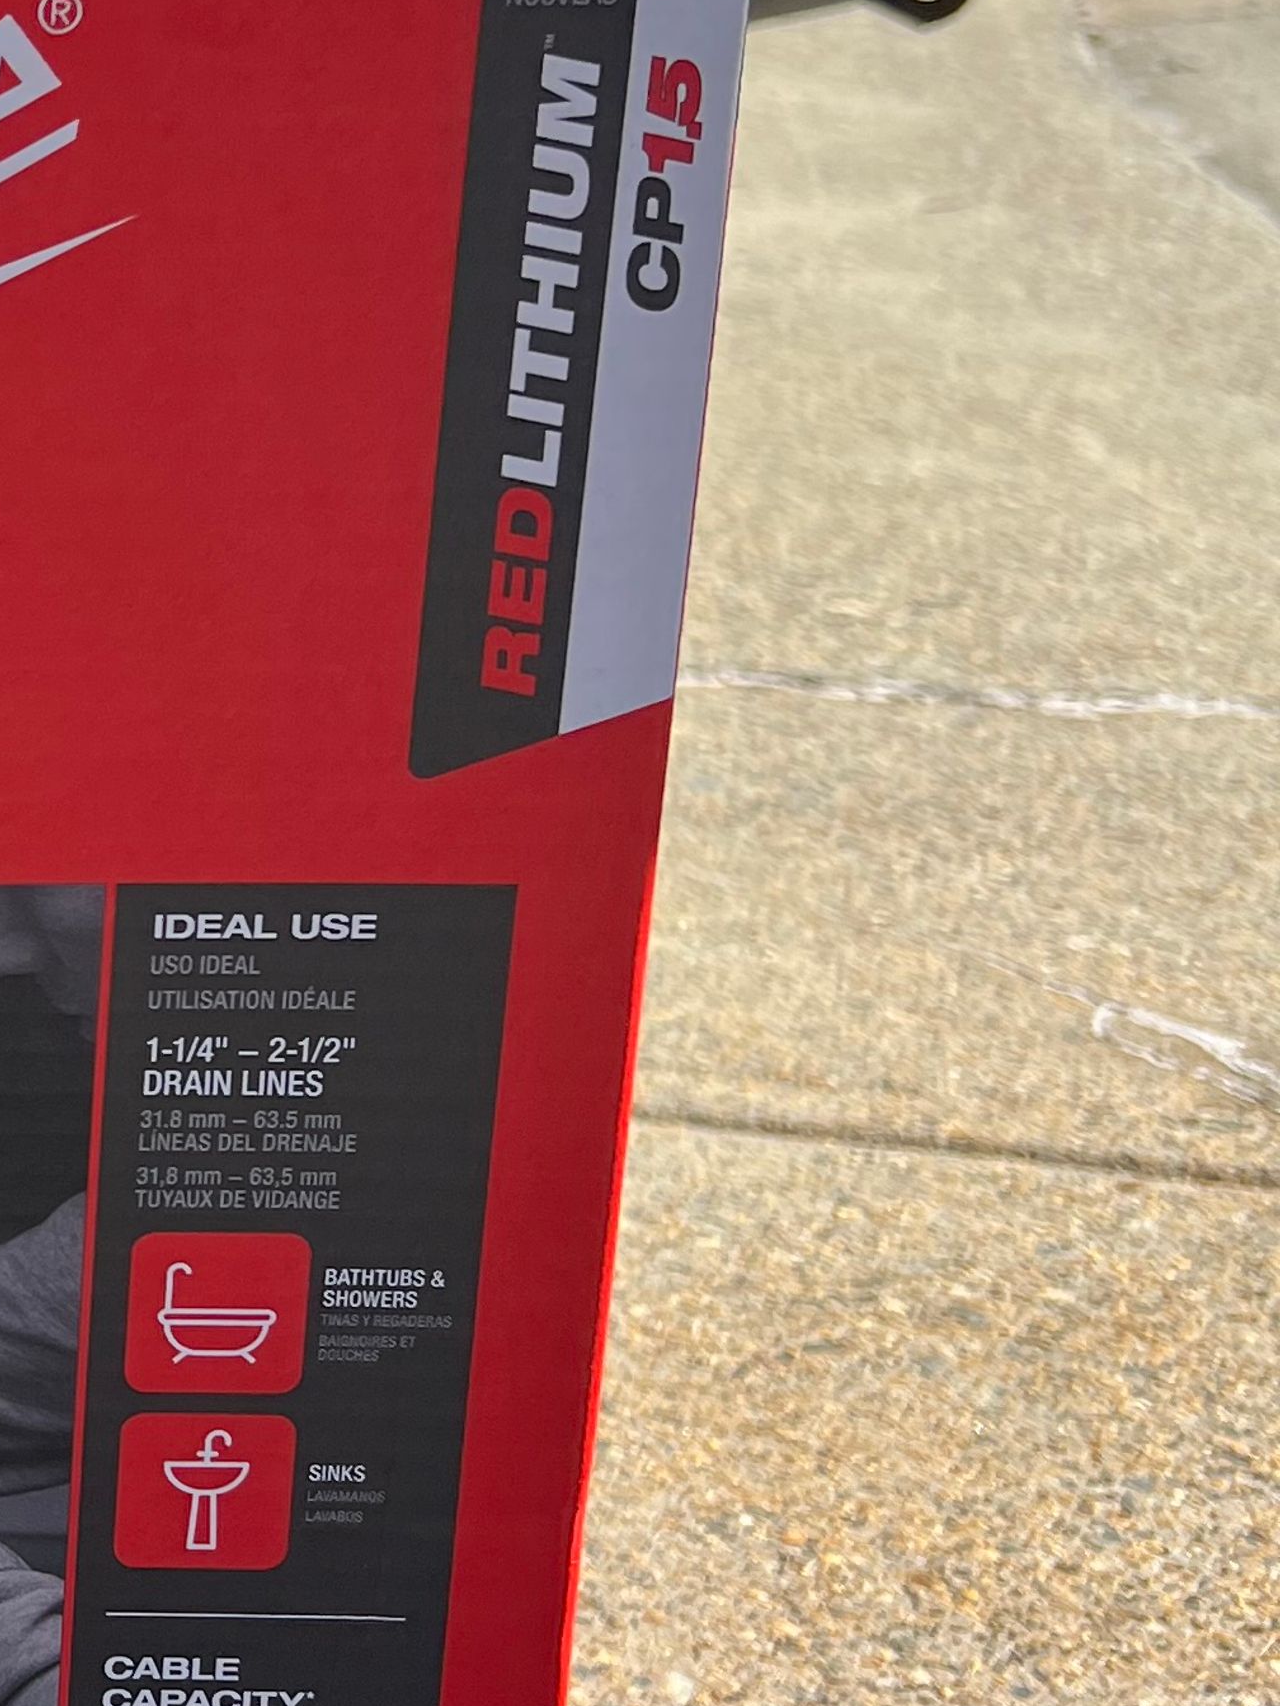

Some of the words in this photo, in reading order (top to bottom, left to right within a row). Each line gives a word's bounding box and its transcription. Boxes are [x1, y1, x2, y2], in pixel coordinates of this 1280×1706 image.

[626, 55, 702, 311] CP1.5
[153, 913, 277, 940] IDEAL
[291, 914, 378, 940] USE
[150, 955, 193, 975] USO
[199, 955, 261, 975] IDEAL
[147, 990, 275, 1010] UTILISATION
[281, 985, 356, 1010] IDÉALE
[145, 1036, 228, 1063] 1-1/4"
[267, 1036, 357, 1064] 2-1/2"
[143, 1070, 232, 1096] DRAIN
[241, 1070, 324, 1097] LINES
[139, 1109, 182, 1129] 31.8
[188, 1113, 226, 1129] mm
[253, 1110, 298, 1129] 63.5
[304, 1113, 342, 1130] mm
[138, 1131, 212, 1153] LÍNEAS
[217, 1133, 256, 1153] DEL
[262, 1133, 358, 1154] DRENAJE
[135, 1167, 178, 1188] 31,8
[184, 1170, 222, 1186] mm
[249, 1167, 294, 1187] 63,5
[300, 1171, 337, 1186] mm
[135, 1189, 214, 1208] TUYAUX
[219, 1189, 246, 1209] DE
[251, 1190, 341, 1210] VIDANGE
[323, 1268, 427, 1287] BATHTUBS
[430, 1270, 446, 1288] &
[322, 1289, 418, 1309] SHOWERS
[362, 1314, 373, 1327] Y
[373, 1314, 453, 1329] REGADERAS
[399, 1335, 416, 1348] ET
[308, 1464, 366, 1483] SINKS
[103, 1655, 240, 1682] CABLE
